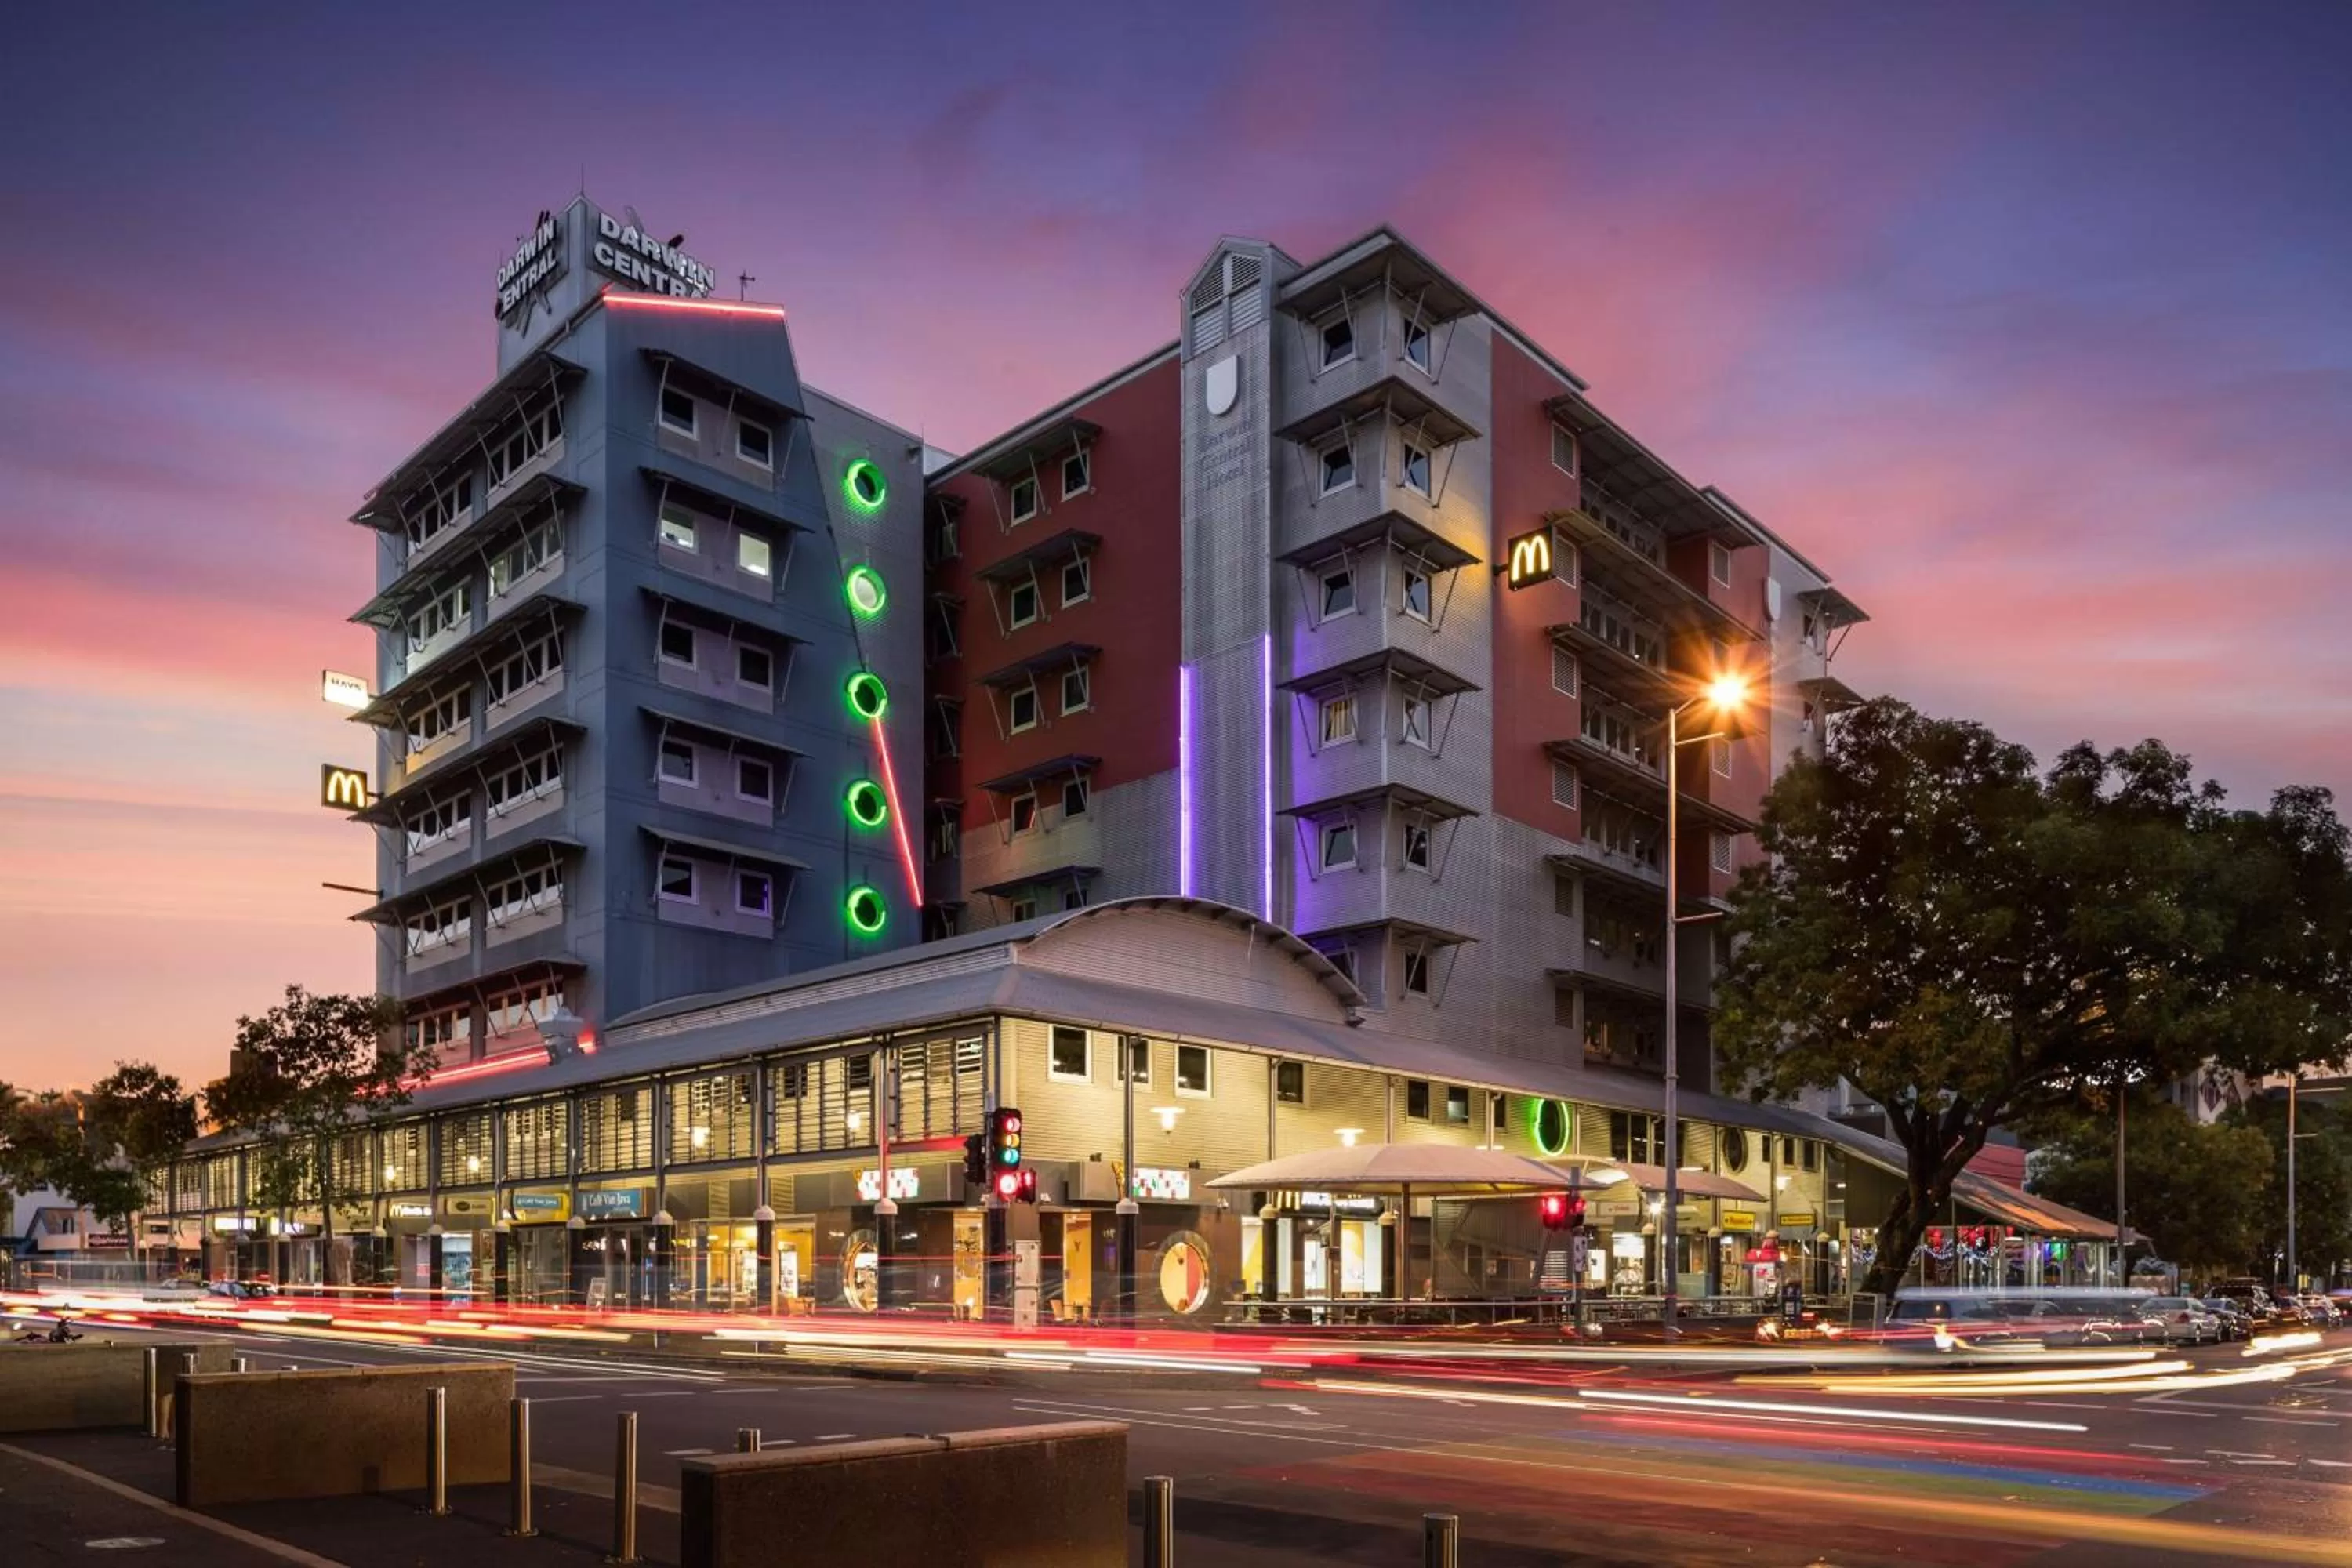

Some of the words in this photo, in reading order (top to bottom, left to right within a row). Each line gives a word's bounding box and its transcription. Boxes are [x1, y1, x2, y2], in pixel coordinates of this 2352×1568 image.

[498, 218, 557, 290] DARWIN
[594, 242, 710, 299] CENTRA
[599, 212, 715, 290] DARWIN
